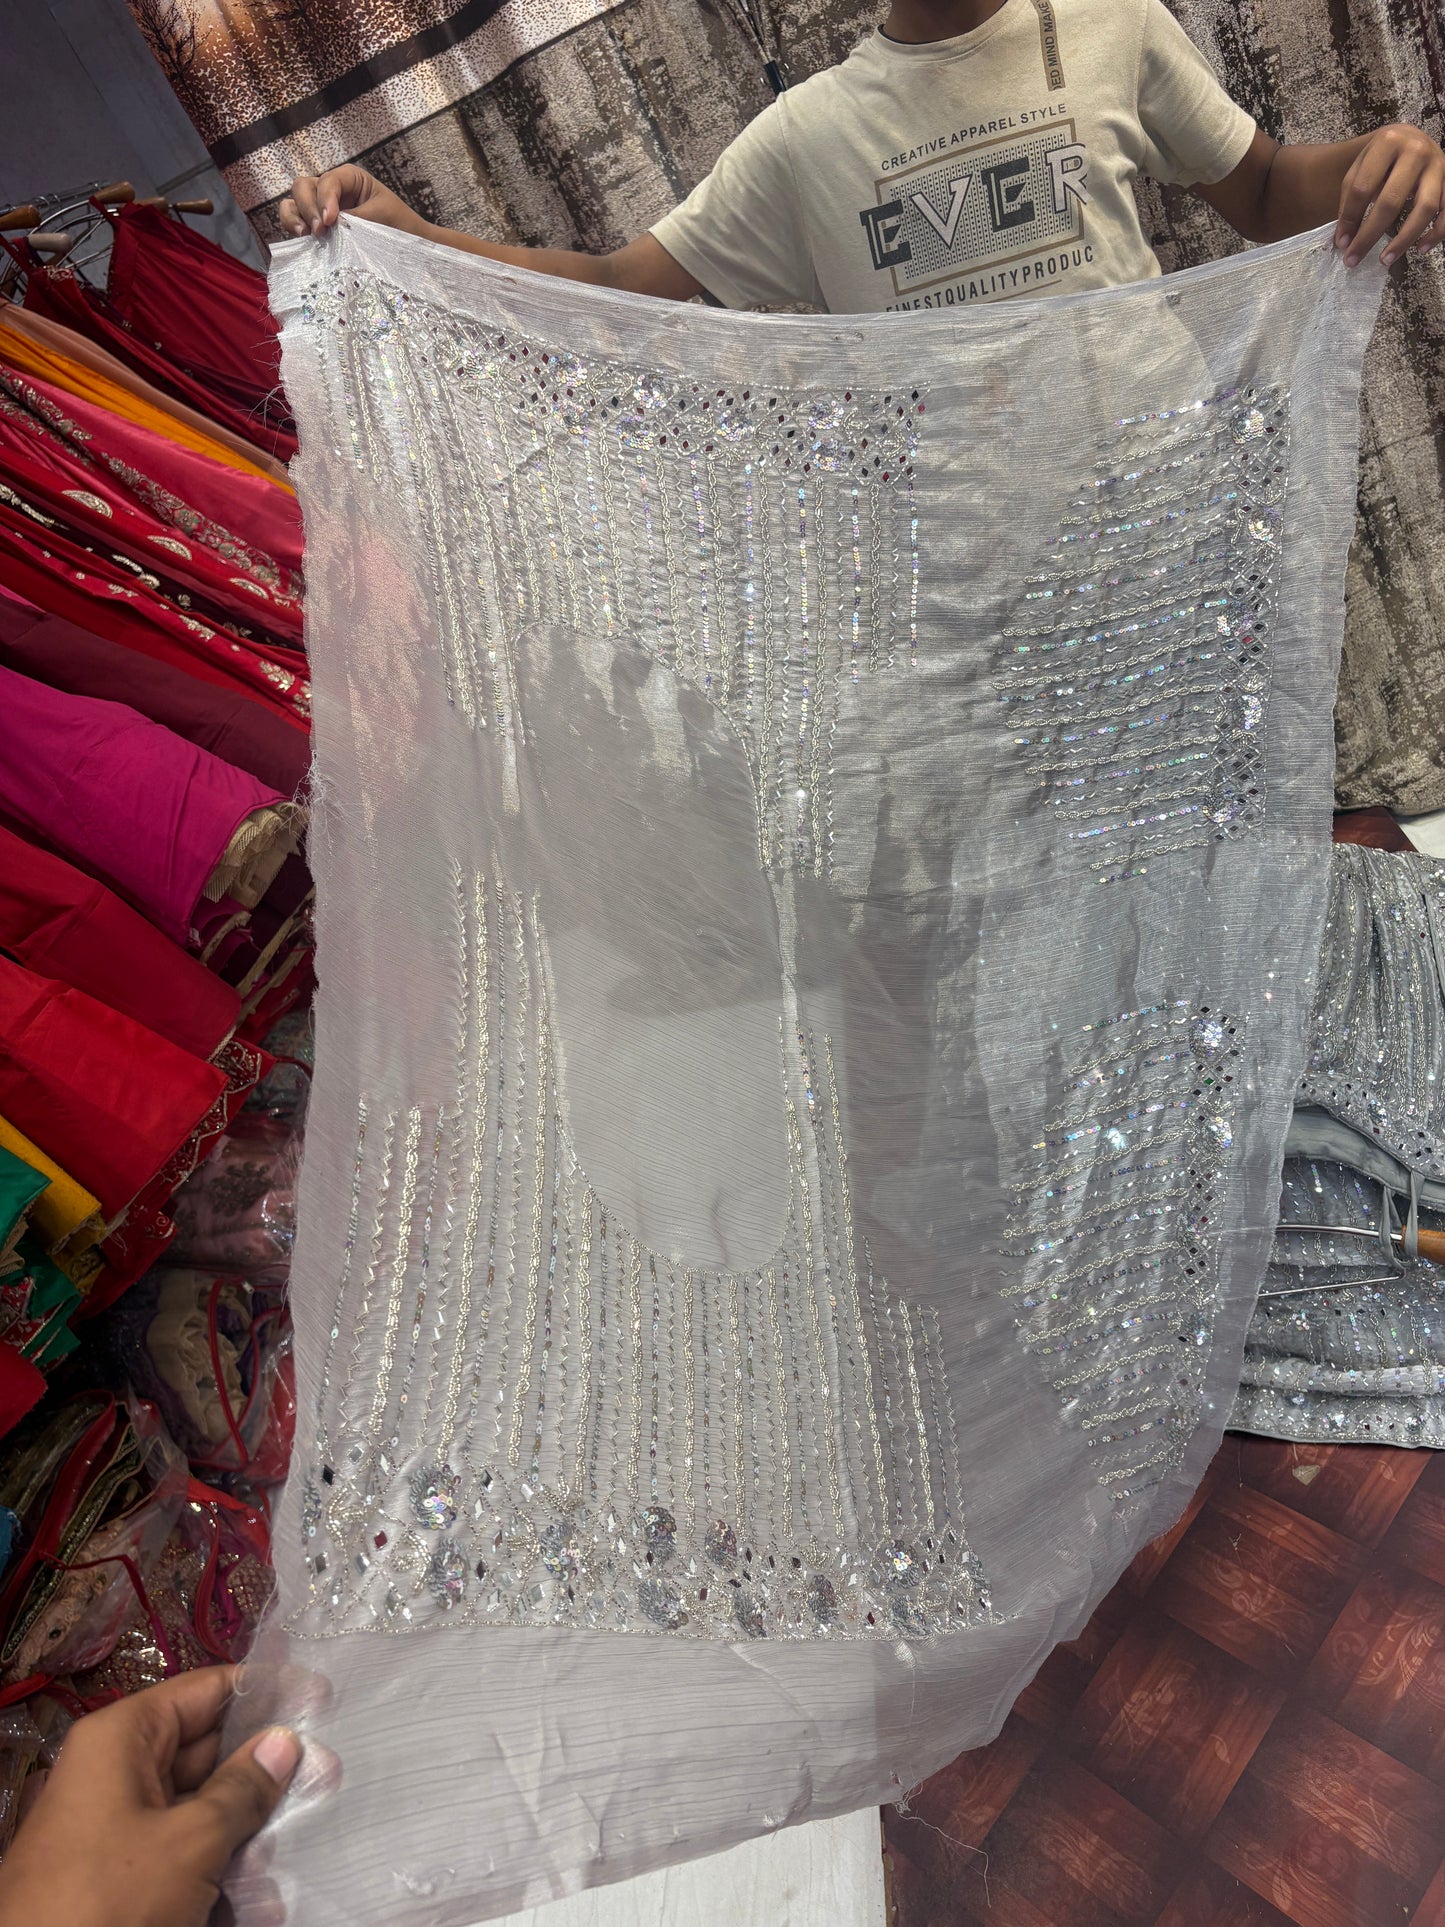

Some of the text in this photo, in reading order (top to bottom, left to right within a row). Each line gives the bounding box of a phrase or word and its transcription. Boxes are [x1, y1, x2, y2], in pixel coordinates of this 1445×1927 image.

[1045, 36, 1058, 68] MIND
[881, 103, 1067, 171] CREATIVE APPAREL STYLE
[859, 142, 1088, 271] EVER
